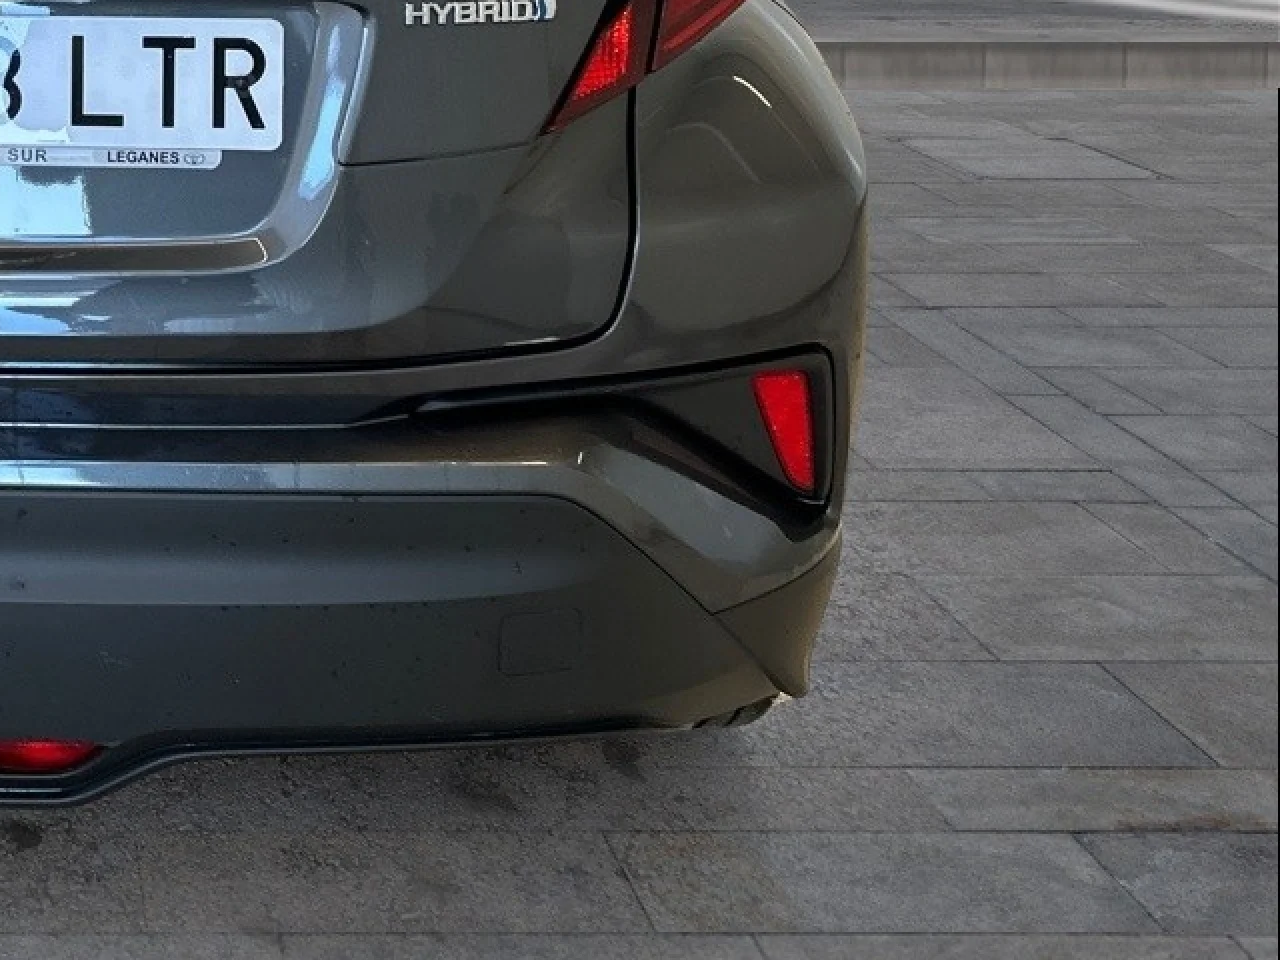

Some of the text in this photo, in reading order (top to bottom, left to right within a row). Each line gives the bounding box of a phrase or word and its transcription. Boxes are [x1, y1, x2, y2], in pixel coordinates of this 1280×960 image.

[405, 0, 534, 25] HYBRID
[71, 35, 266, 129] LTR
[7, 147, 48, 163] SUR
[107, 150, 180, 165] LEGANES
